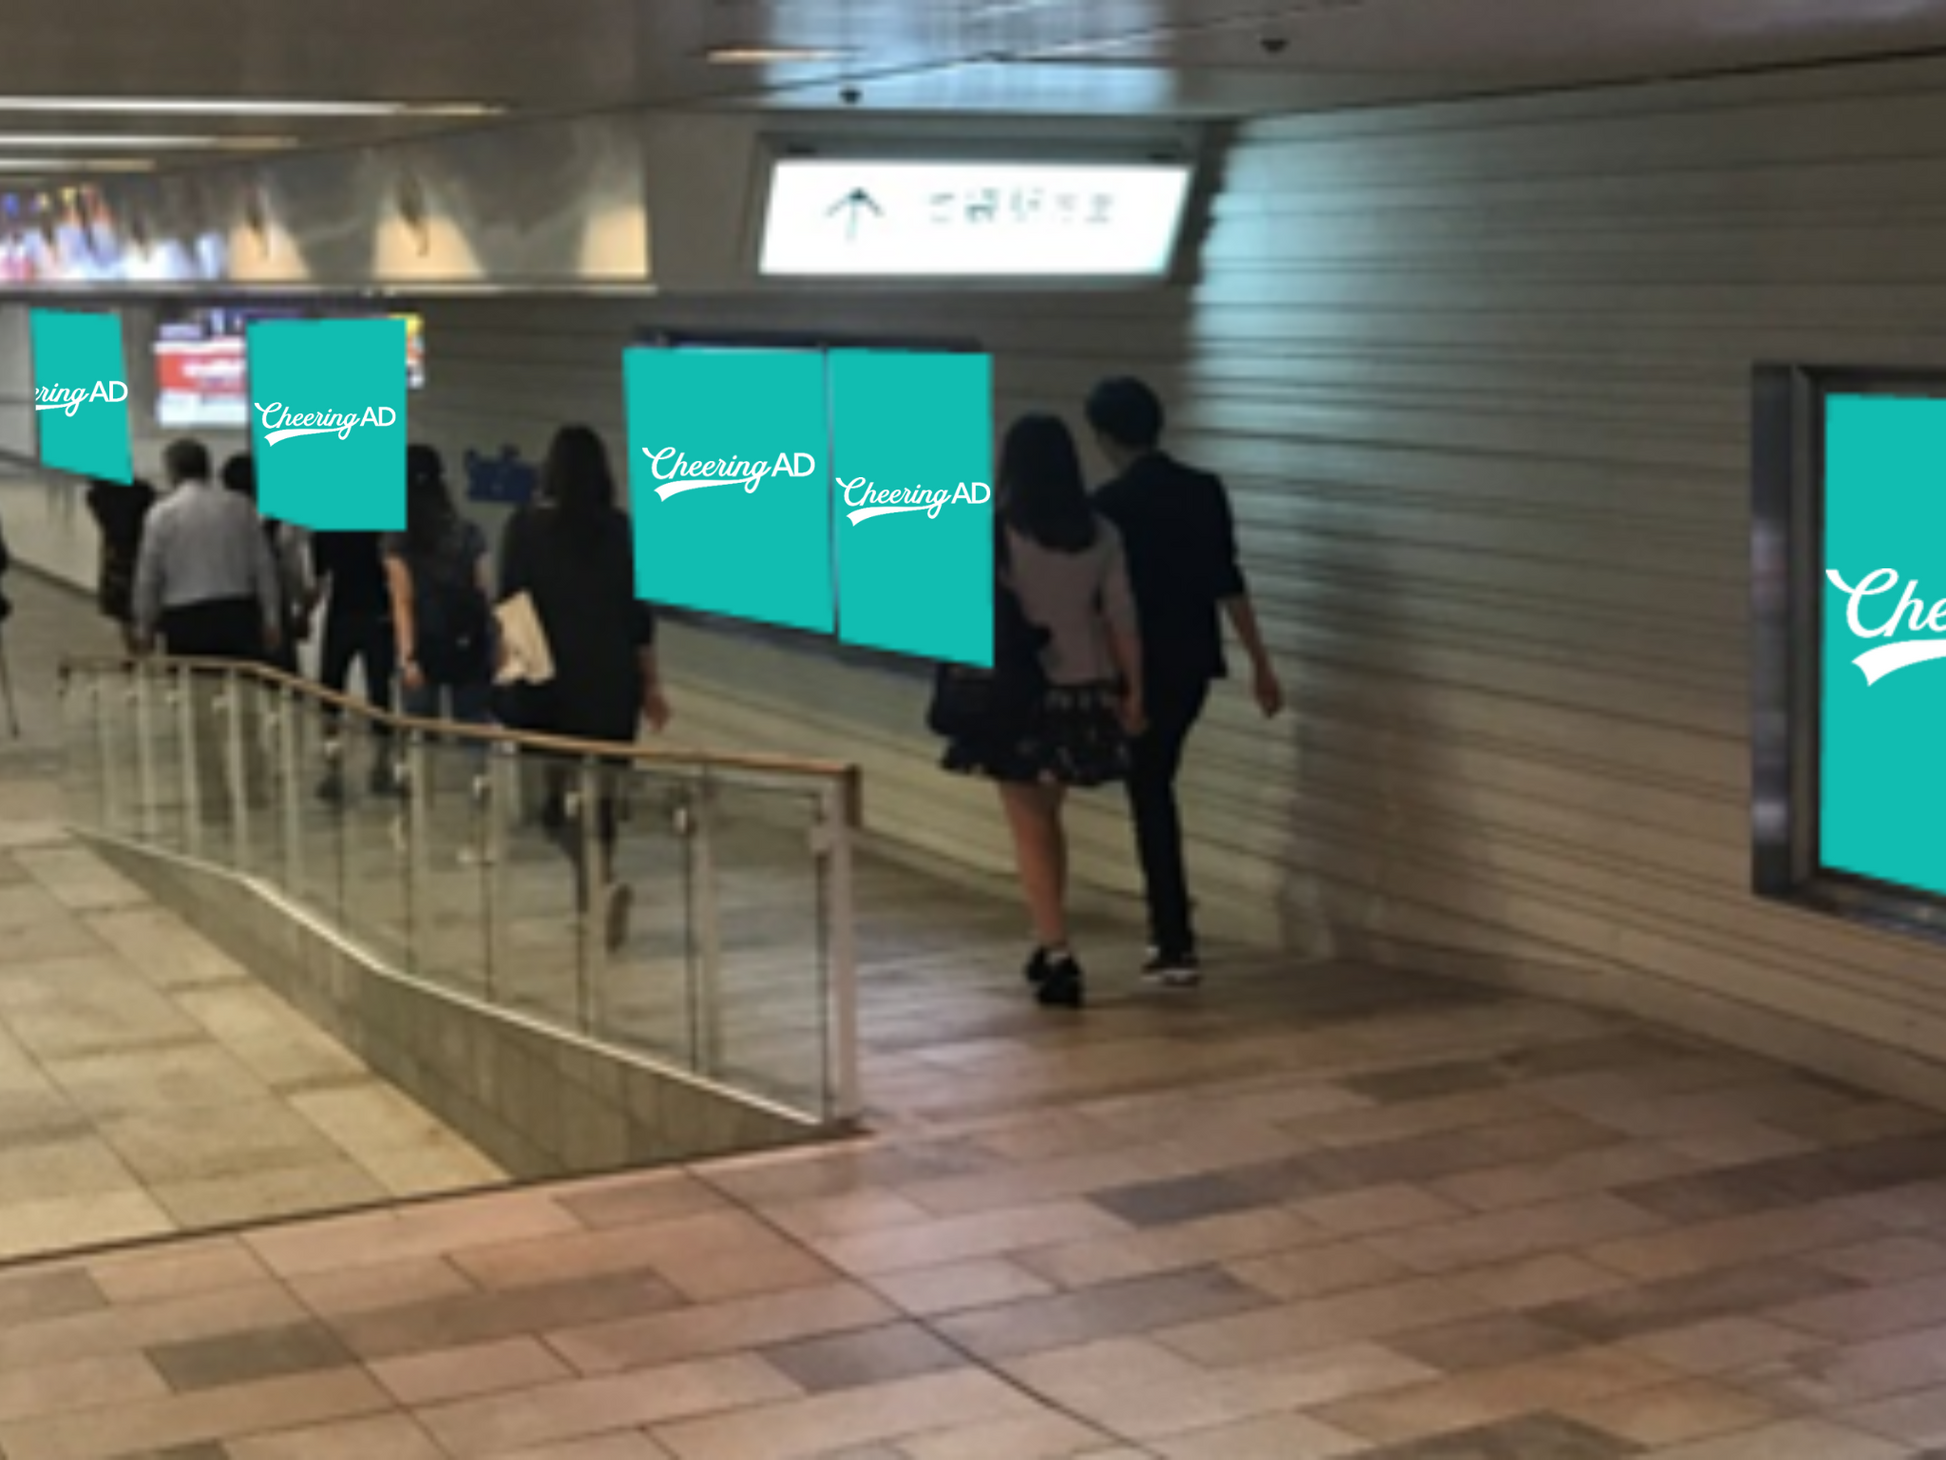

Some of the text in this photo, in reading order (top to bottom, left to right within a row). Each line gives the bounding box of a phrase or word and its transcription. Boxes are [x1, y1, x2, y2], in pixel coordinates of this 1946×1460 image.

[88, 380, 128, 402] AD
[254, 402, 396, 447] Cheering AD
[641, 446, 815, 502] Cheering AD
[835, 476, 991, 527] Cheering AD
